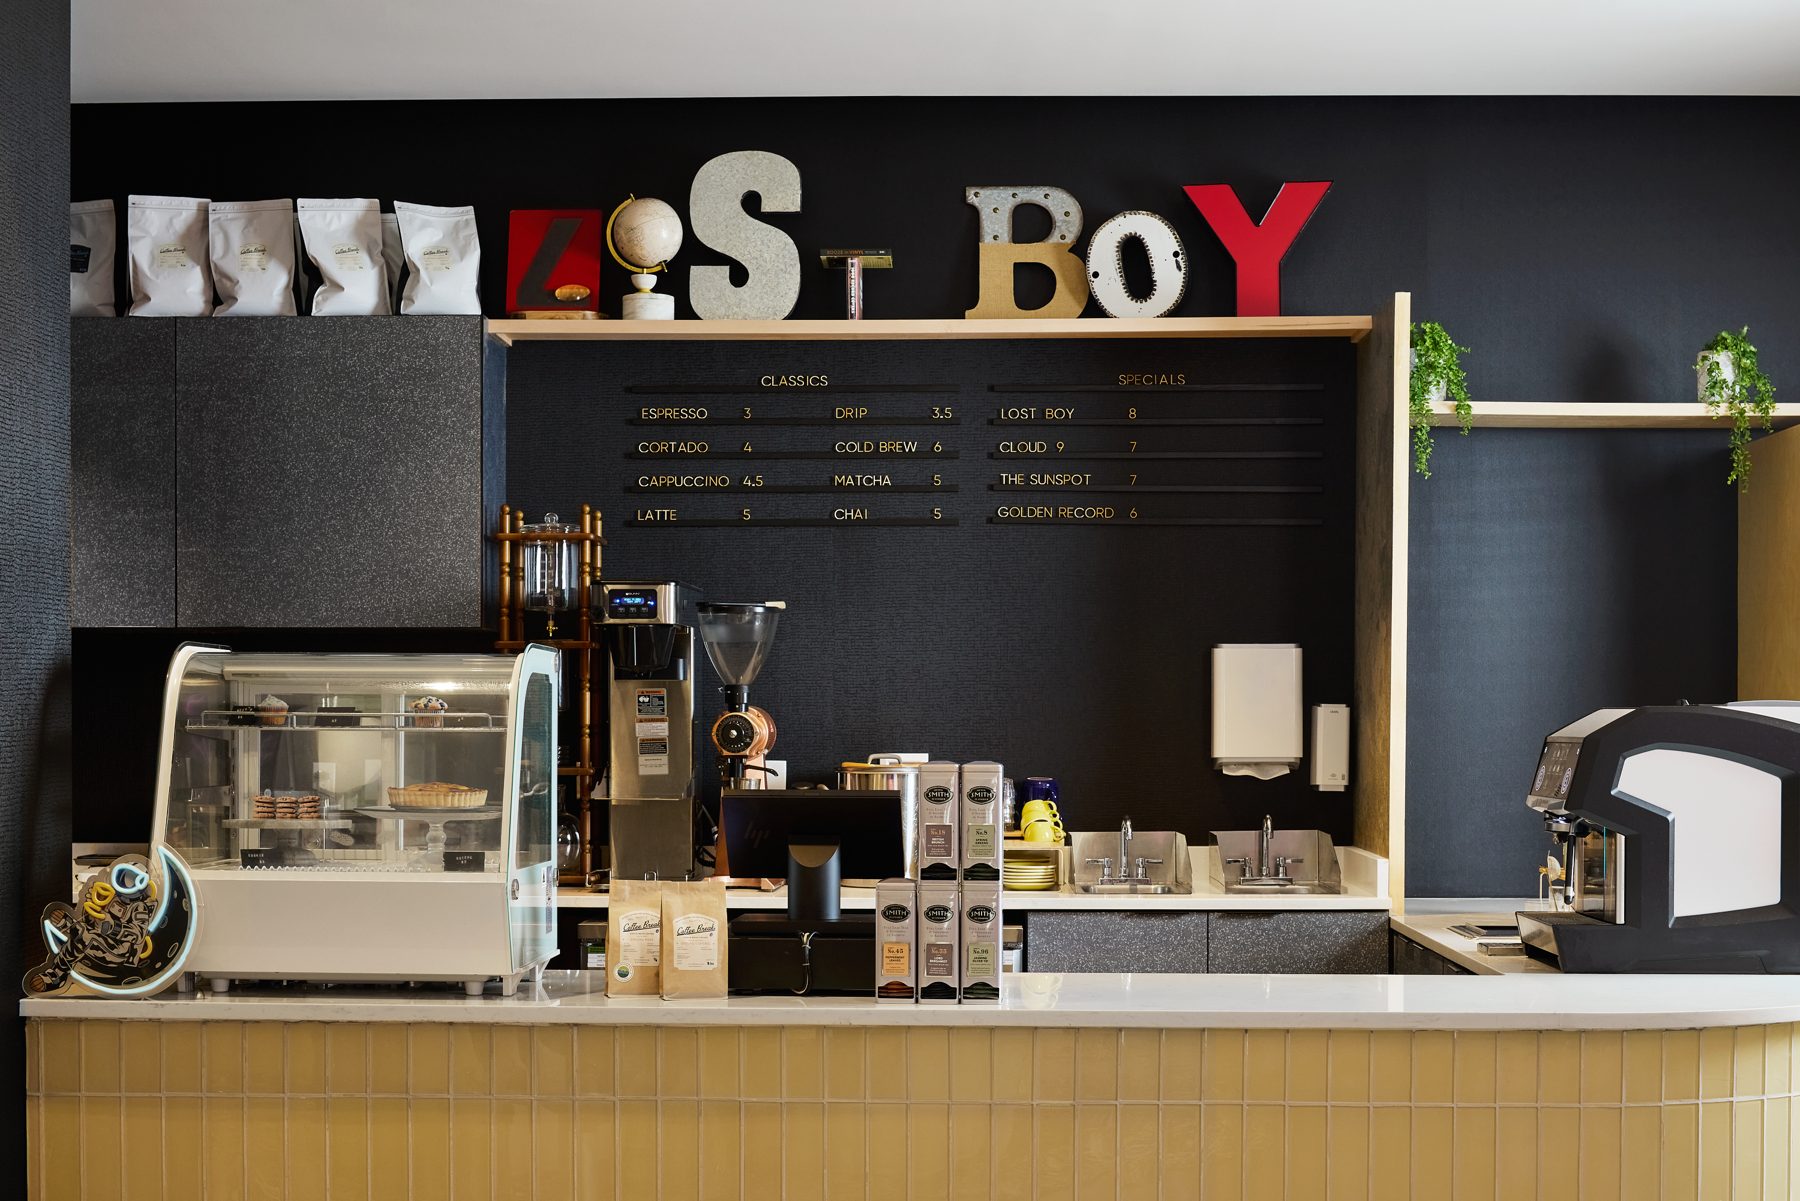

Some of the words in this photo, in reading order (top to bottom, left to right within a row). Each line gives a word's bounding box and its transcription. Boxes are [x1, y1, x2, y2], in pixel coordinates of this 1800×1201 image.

[965, 180, 1333, 319] BOY
[760, 374, 829, 388] CLASSICS
[1118, 373, 1186, 386] SPECIALS
[641, 407, 708, 420] ESPRESSO
[743, 407, 752, 420] 3
[834, 407, 868, 420] DRIP
[931, 407, 953, 420] 3.5
[1000, 407, 1037, 420] LOST
[1044, 407, 1075, 420] BOY
[1127, 407, 1138, 420] 8
[637, 441, 709, 454] CORTADO
[742, 441, 753, 454] 4
[834, 441, 874, 454] COLD
[878, 441, 918, 454] BREW
[932, 441, 943, 454] 6
[998, 441, 1047, 454] CLOUD
[1055, 441, 1066, 454] 9
[1128, 441, 1138, 454] 7
[637, 475, 730, 488] CAPPUCCINO
[742, 475, 764, 488] 4.5
[833, 474, 892, 487] MATCHA
[932, 474, 942, 487] 5
[999, 473, 1025, 486] THE
[1028, 473, 1092, 486] SUNSPOT
[1128, 474, 1138, 486] 7
[636, 509, 678, 522] LATTE
[742, 508, 752, 521] 5
[833, 508, 868, 521] CHAI
[933, 507, 943, 520] 5
[997, 506, 1054, 519] GOLDEN
[1057, 506, 1115, 519] RECORD
[1128, 507, 1138, 519] 6
